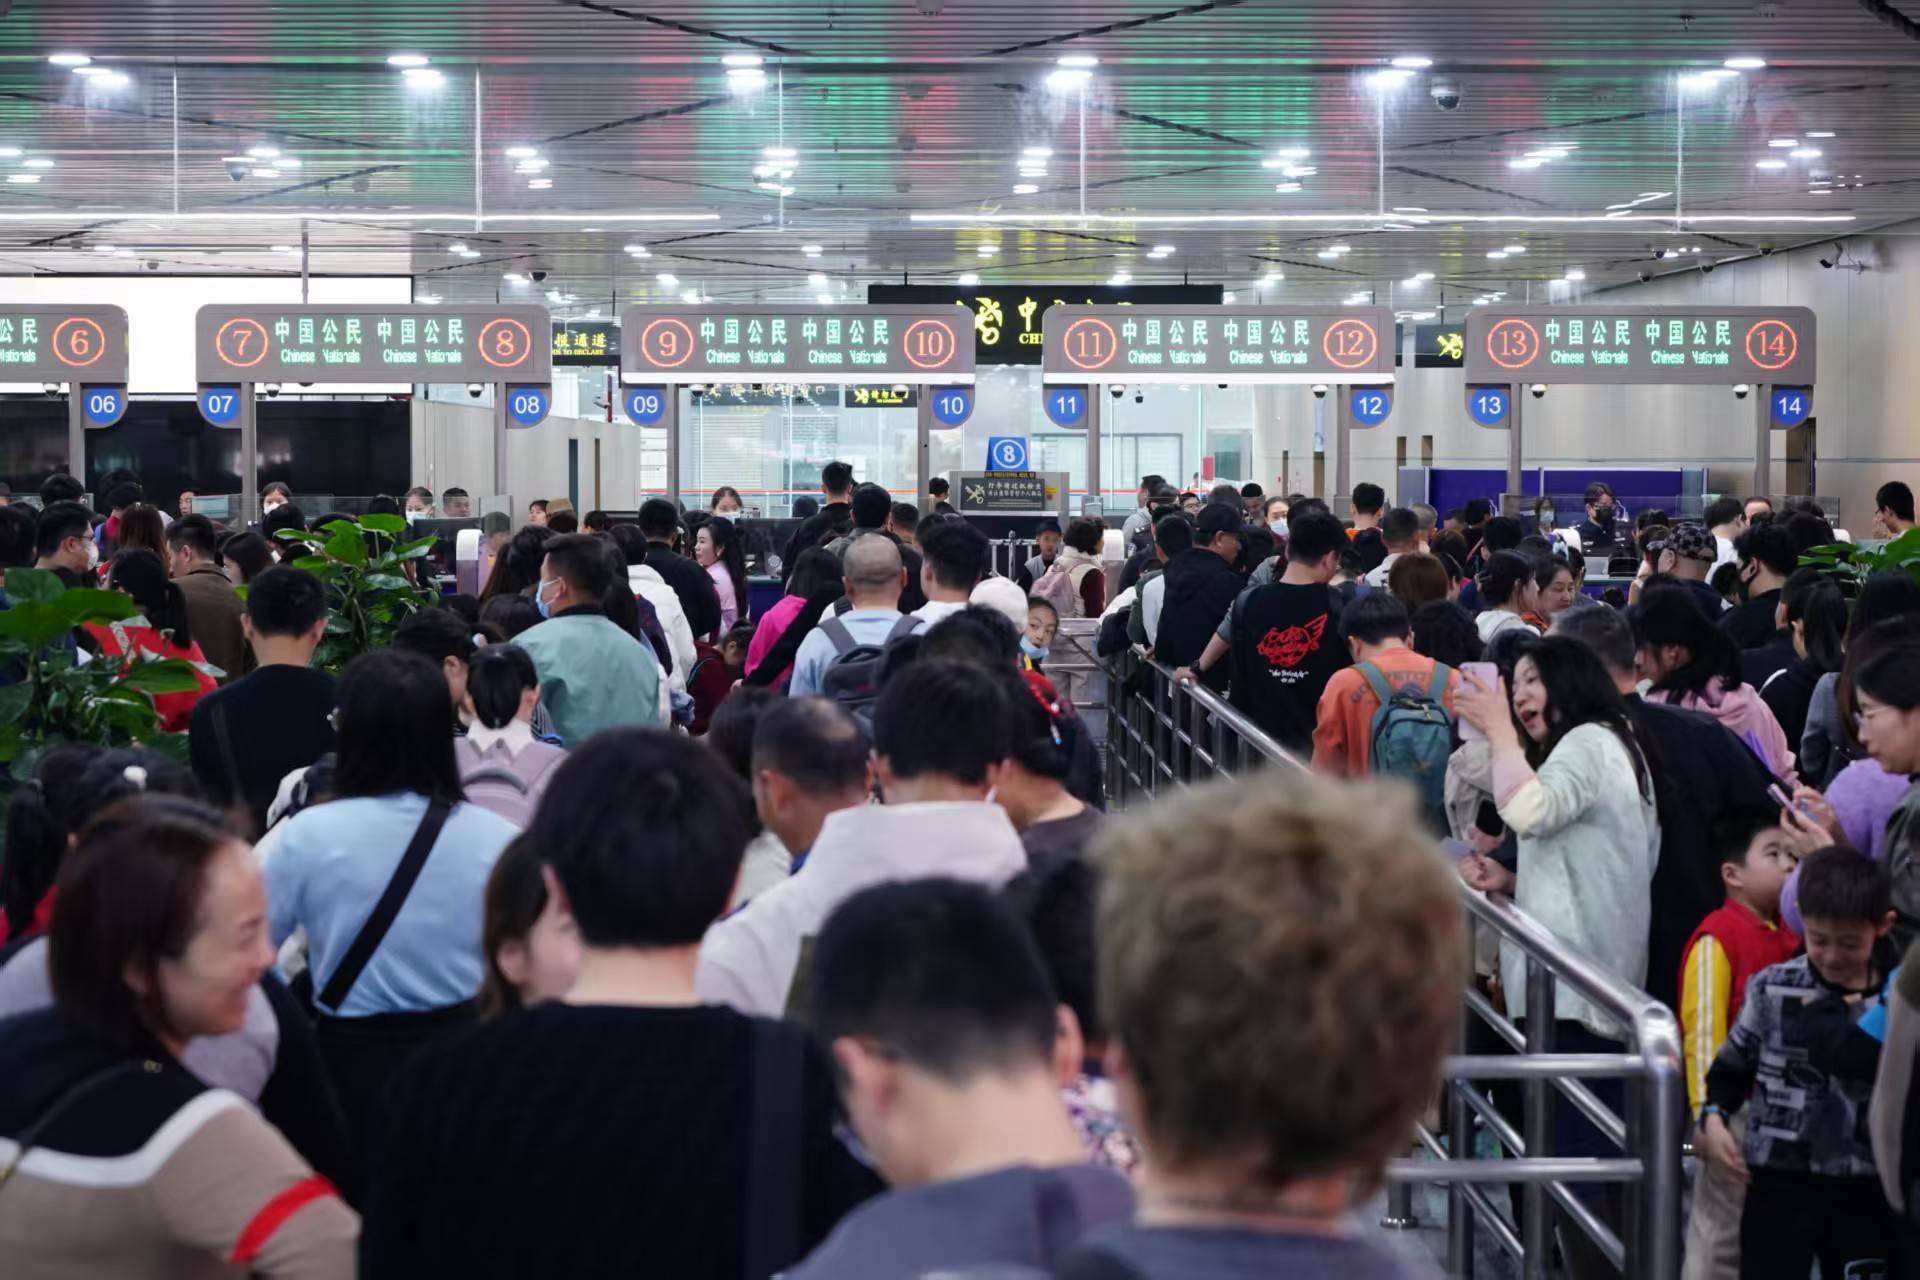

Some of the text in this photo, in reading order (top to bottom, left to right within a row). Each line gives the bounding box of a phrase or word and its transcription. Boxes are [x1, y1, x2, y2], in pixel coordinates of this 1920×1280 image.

[276, 318, 464, 345] 中国公民 中国公民
[701, 318, 889, 345] 中国公民 中国公民
[1122, 318, 1309, 346] 中国公民 中国公民
[1545, 318, 1731, 346] 中国公民 中国公民
[71, 329, 89, 356] 6
[233, 330, 252, 356] 7
[496, 330, 515, 356] 8
[658, 331, 678, 356] 9
[916, 330, 943, 357] 10
[1077, 331, 1103, 357] 11
[1336, 330, 1363, 356] 12
[1499, 330, 1527, 356] 13
[1757, 331, 1786, 356] 14
[281, 349, 316, 364] Chinese
[382, 349, 417, 364] Chinese
[706, 349, 741, 364] Chinese
[807, 349, 842, 364] Chinese
[1128, 349, 1163, 364] Chinese
[1230, 349, 1265, 364] Chinese
[1550, 349, 1585, 364] Chinese
[1651, 349, 1686, 364] Chinese
[90, 396, 116, 414] 06
[208, 396, 233, 414] 07
[515, 396, 540, 414] 08
[633, 396, 658, 414] 09
[940, 396, 964, 415] 10
[1056, 397, 1076, 414] 11
[1358, 397, 1382, 414] 12
[1477, 397, 1501, 414] 13
[1778, 397, 1801, 414] 14
[1003, 445, 1016, 463] 8
